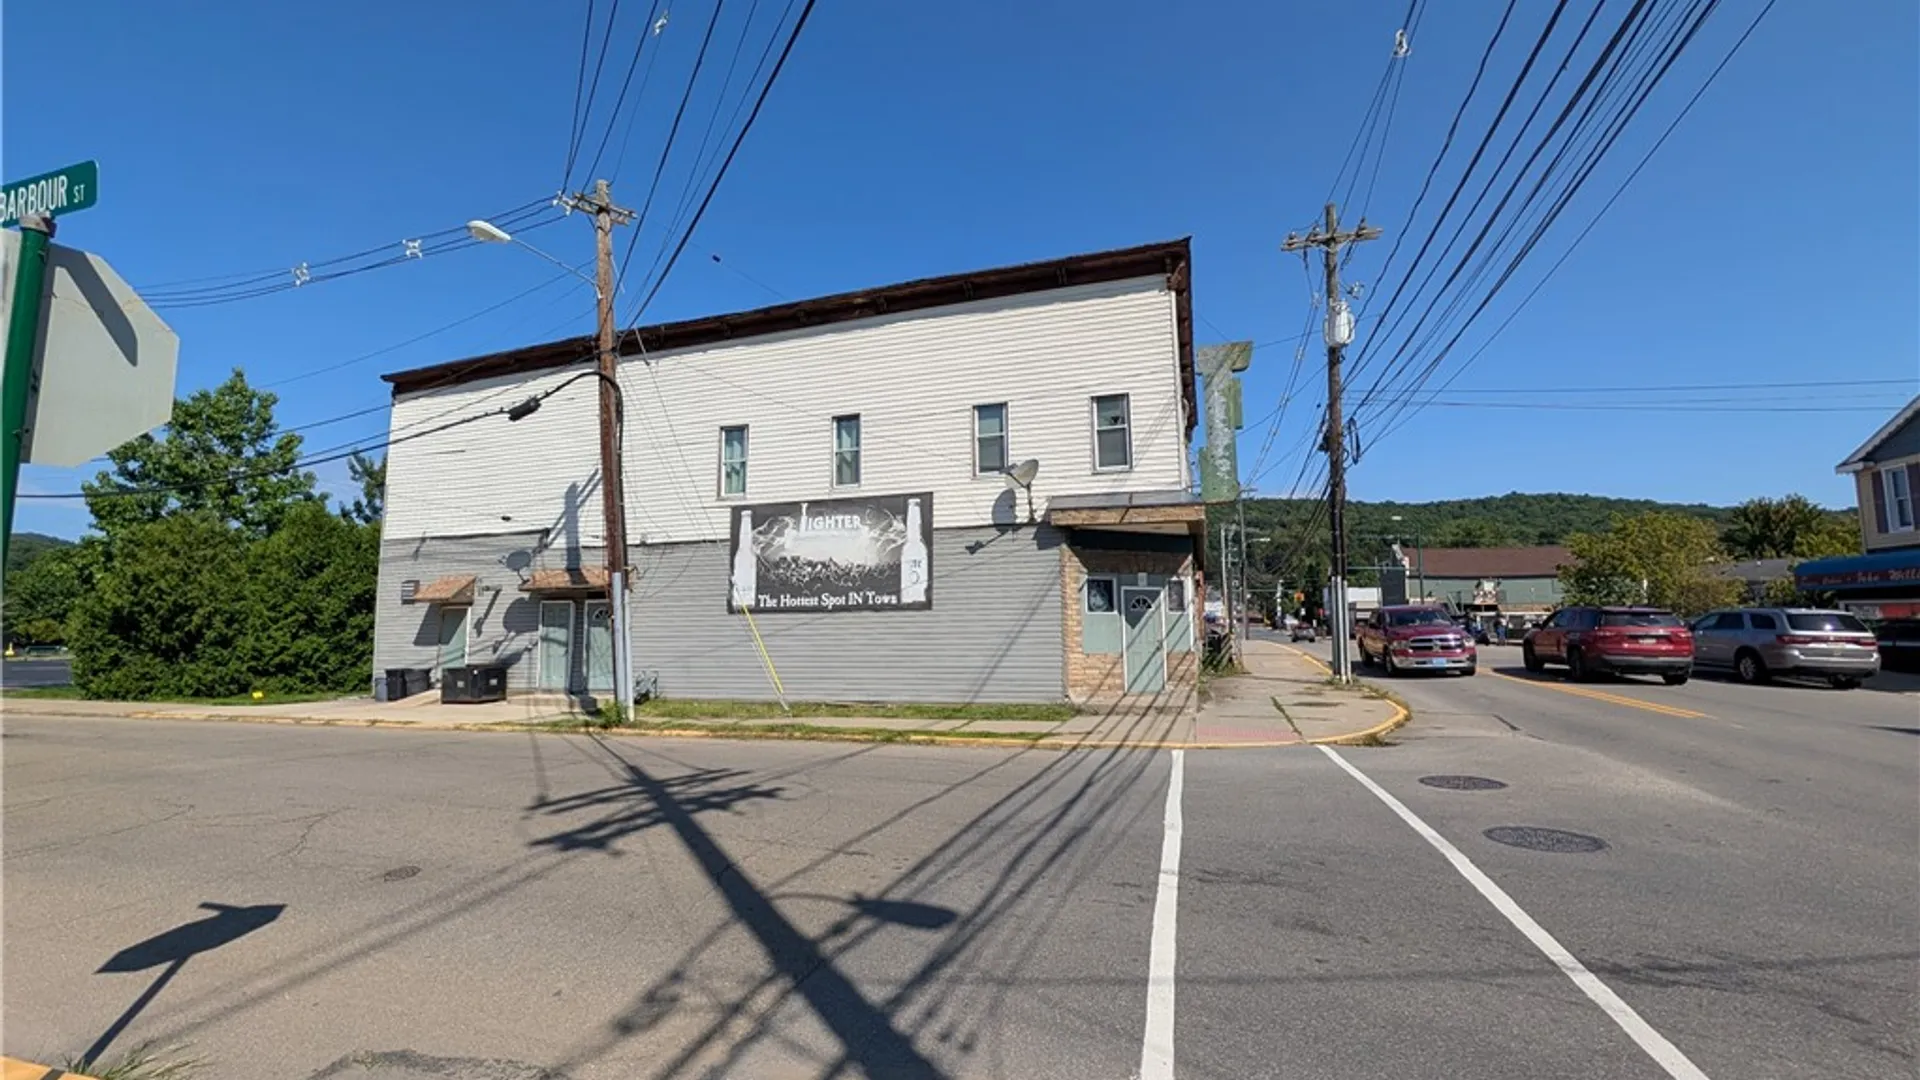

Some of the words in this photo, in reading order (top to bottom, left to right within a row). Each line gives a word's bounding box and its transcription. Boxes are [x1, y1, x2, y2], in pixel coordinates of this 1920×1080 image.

[0, 175, 68, 222] BARBOUR
[73, 184, 86, 203] ST
[758, 594, 777, 608] The
[780, 593, 819, 607] Hottest
[820, 592, 846, 610] Spot
[848, 591, 864, 605] IN
[865, 590, 898, 605] Town
